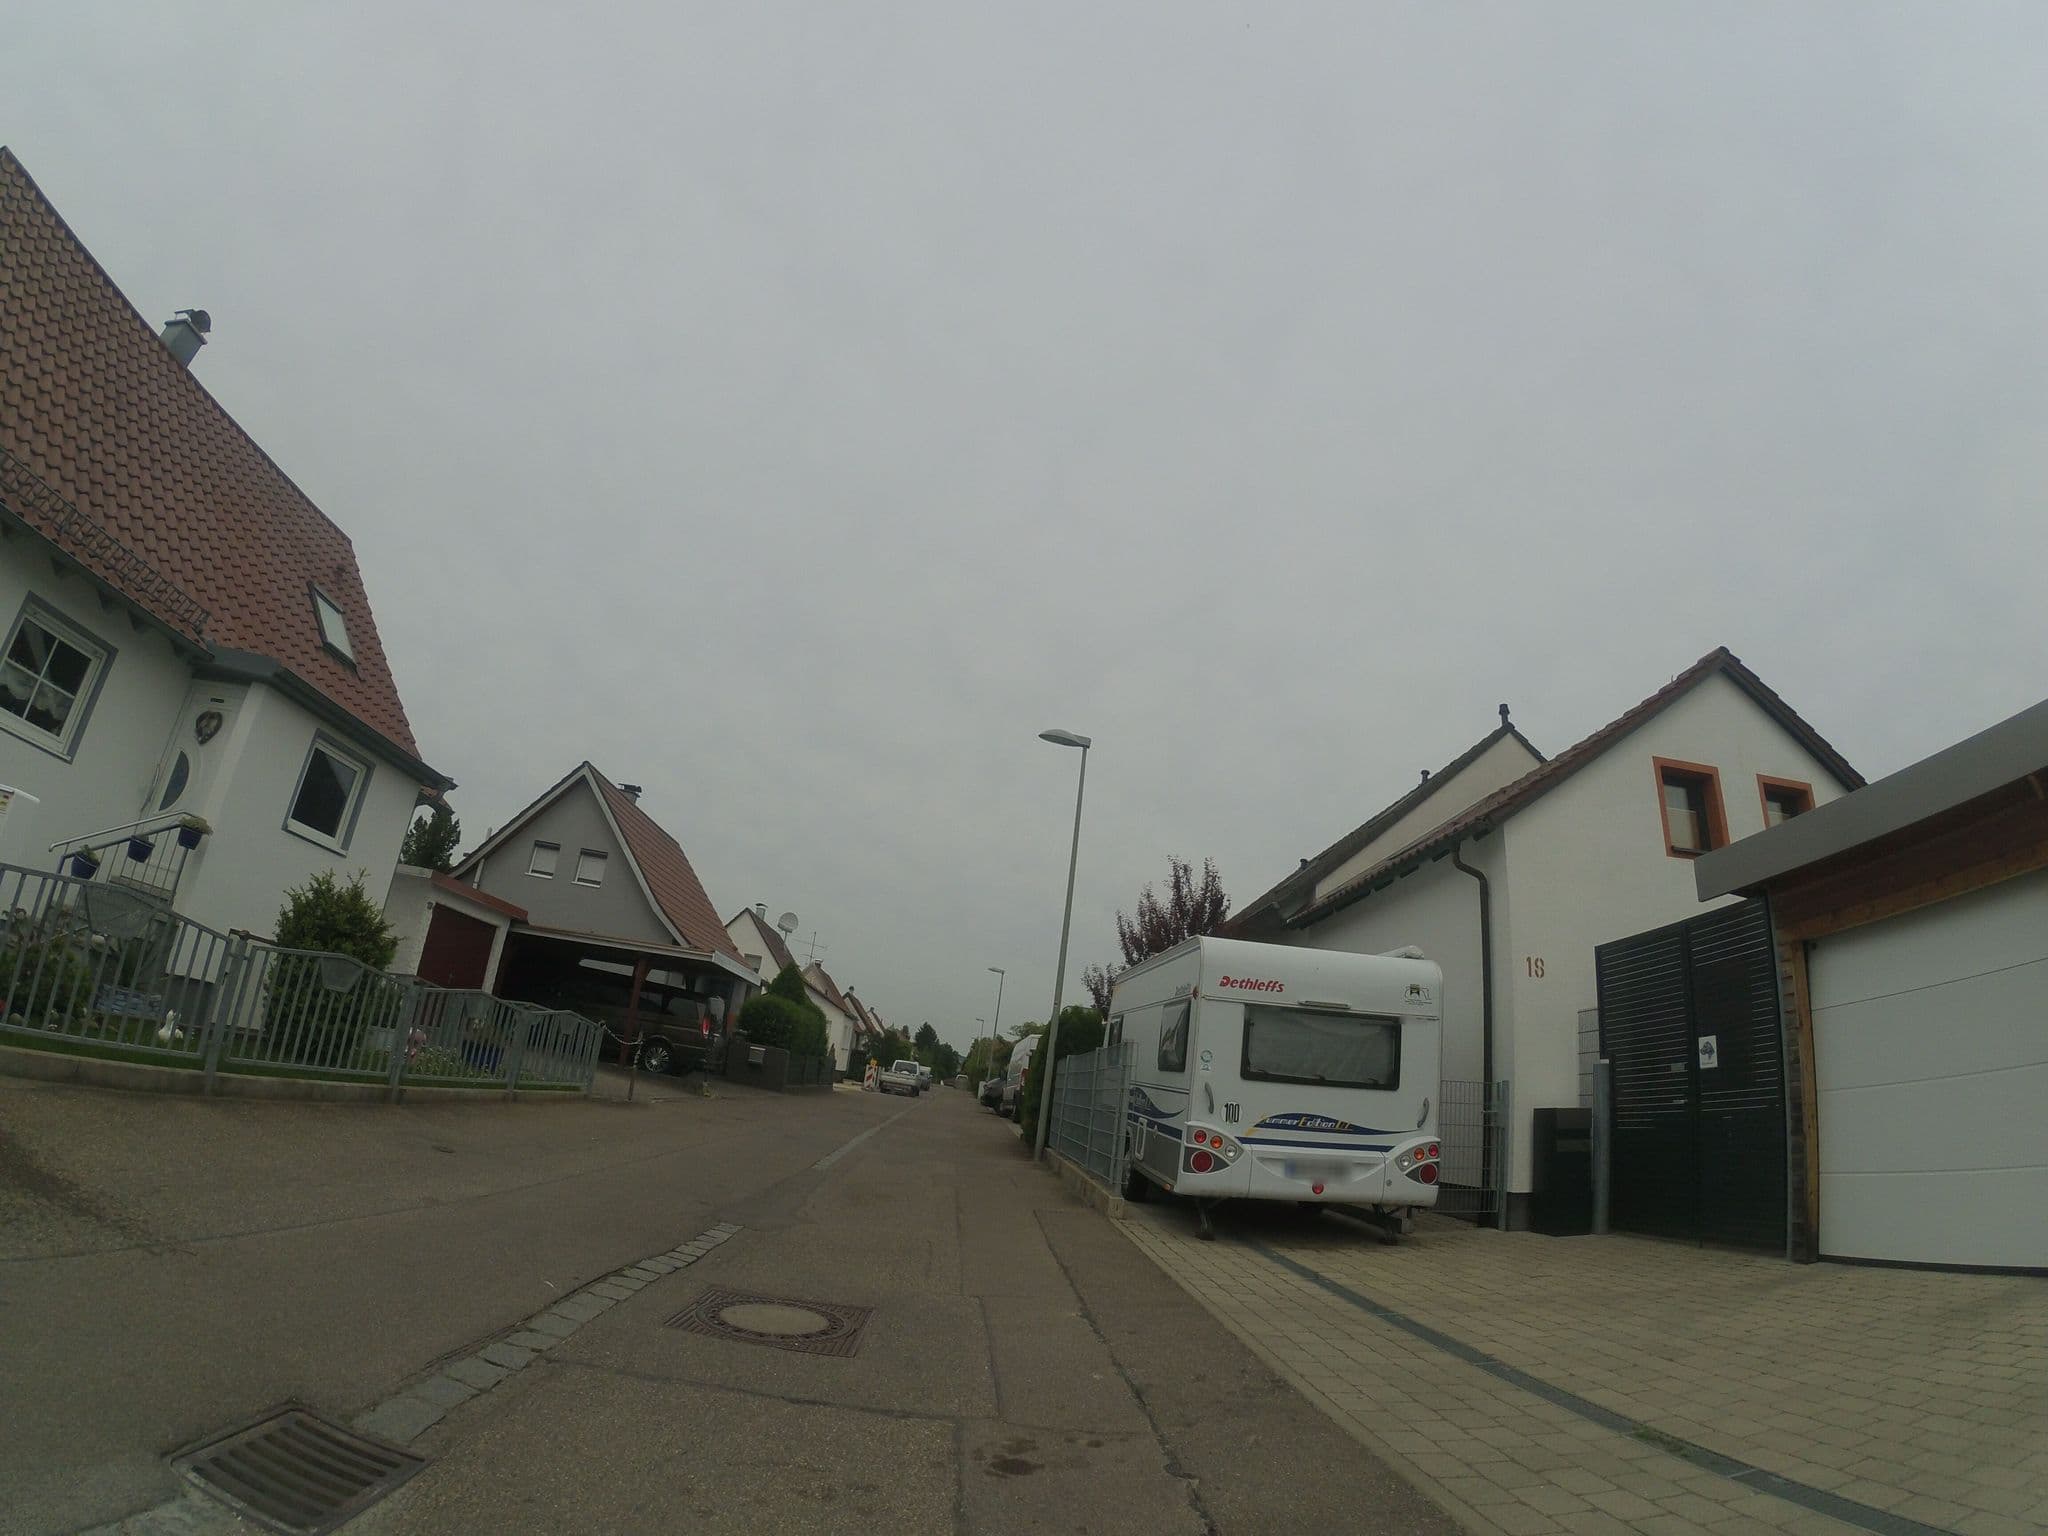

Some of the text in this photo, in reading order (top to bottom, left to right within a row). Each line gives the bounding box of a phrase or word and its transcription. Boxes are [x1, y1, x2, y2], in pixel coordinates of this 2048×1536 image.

[1526, 956, 1545, 979] 18
[1219, 975, 1285, 993] Dethleffs
[1224, 1103, 1240, 1124] 100
